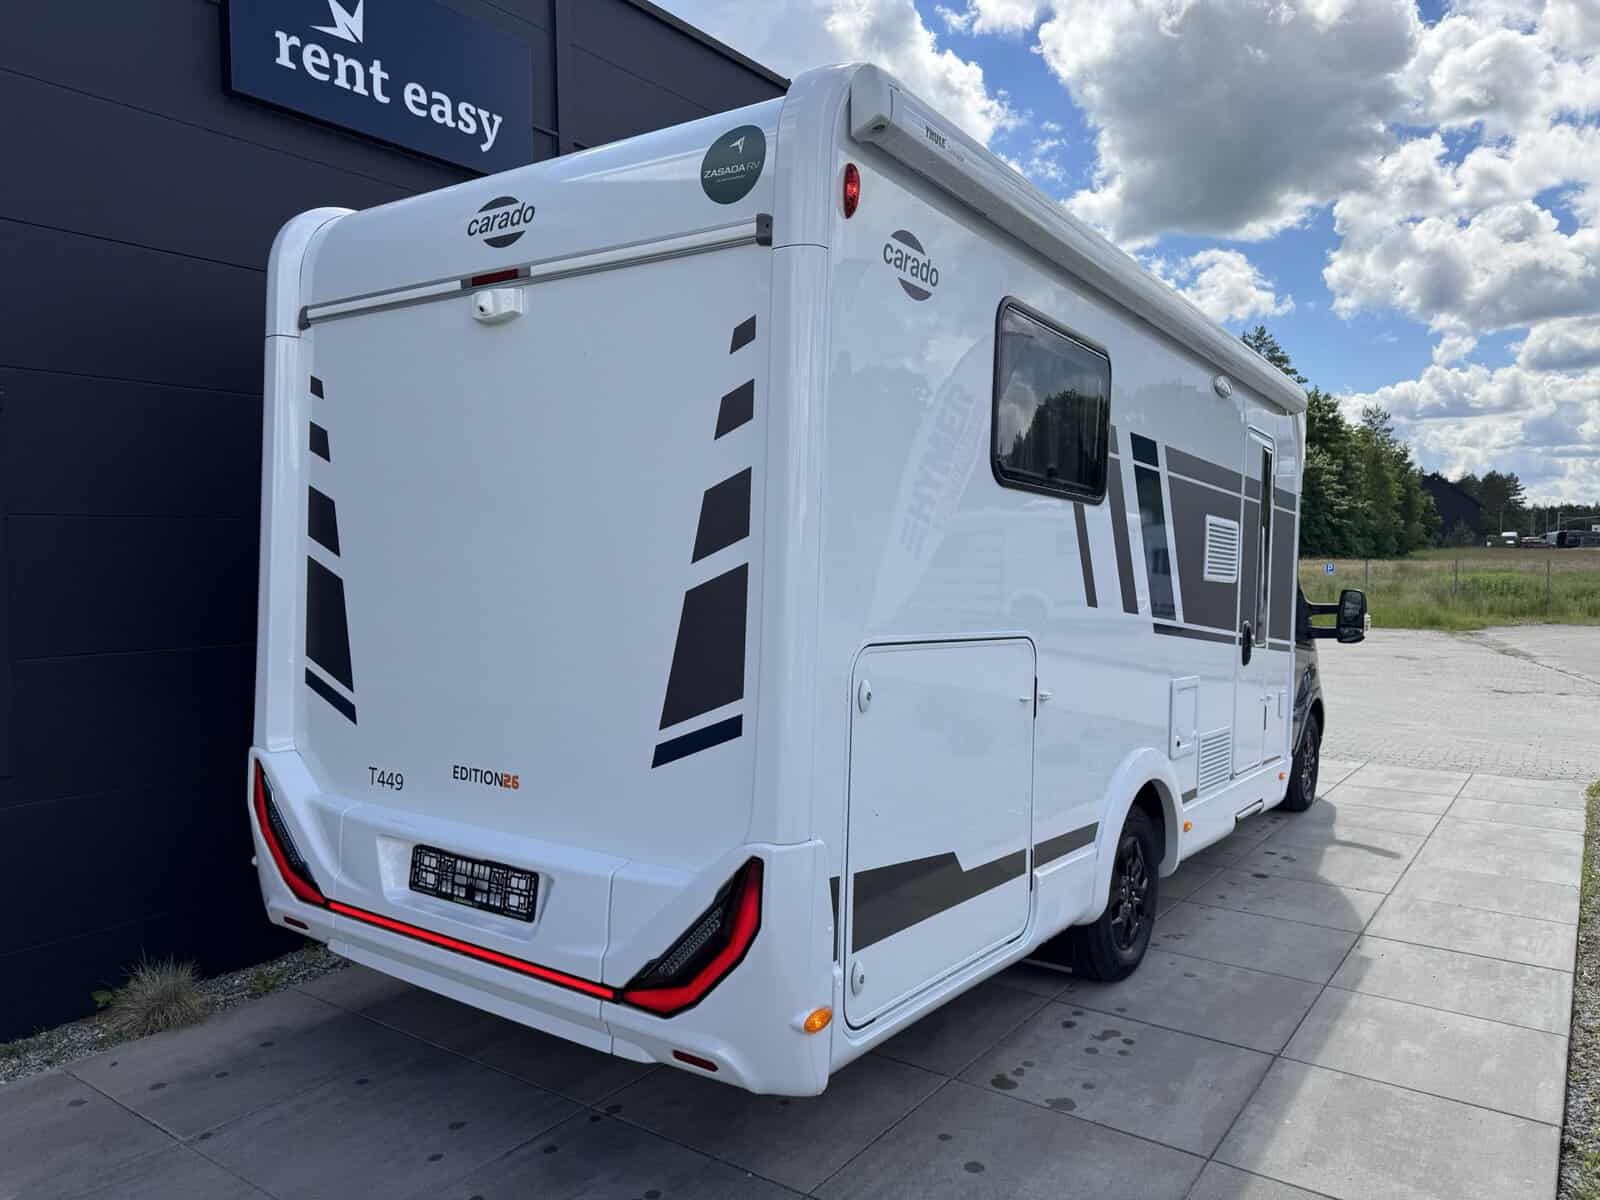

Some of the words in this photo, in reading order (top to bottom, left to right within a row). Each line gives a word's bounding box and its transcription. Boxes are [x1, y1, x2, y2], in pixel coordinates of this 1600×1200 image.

[274, 29, 391, 104] rent
[403, 81, 503, 153] easy
[704, 163, 746, 179] ZASADA
[746, 160, 761, 171] RV
[467, 201, 536, 237] carado
[883, 243, 939, 288] carado
[367, 766, 405, 791] T449
